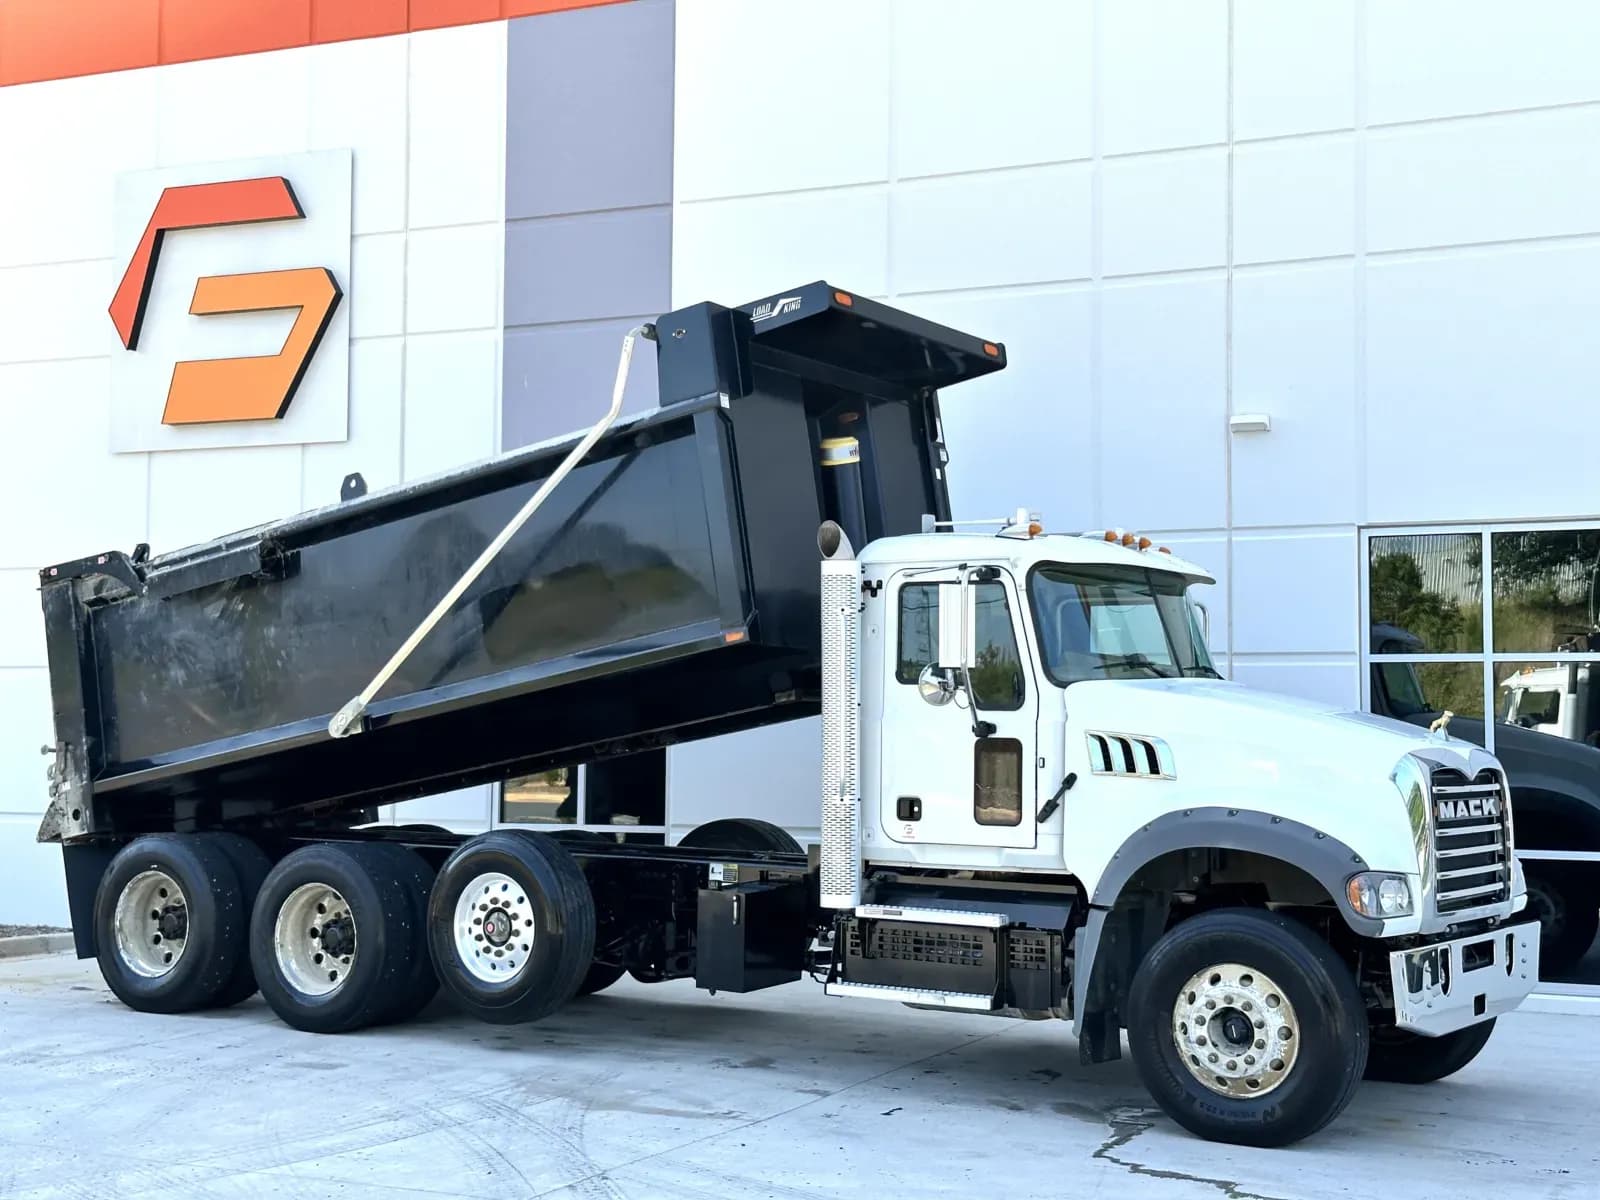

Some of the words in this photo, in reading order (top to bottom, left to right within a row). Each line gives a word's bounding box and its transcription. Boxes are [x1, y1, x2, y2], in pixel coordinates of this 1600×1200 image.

[752, 302, 771, 317] LOAD
[783, 299, 801, 314] KING
[1439, 798, 1497, 819] MACK
